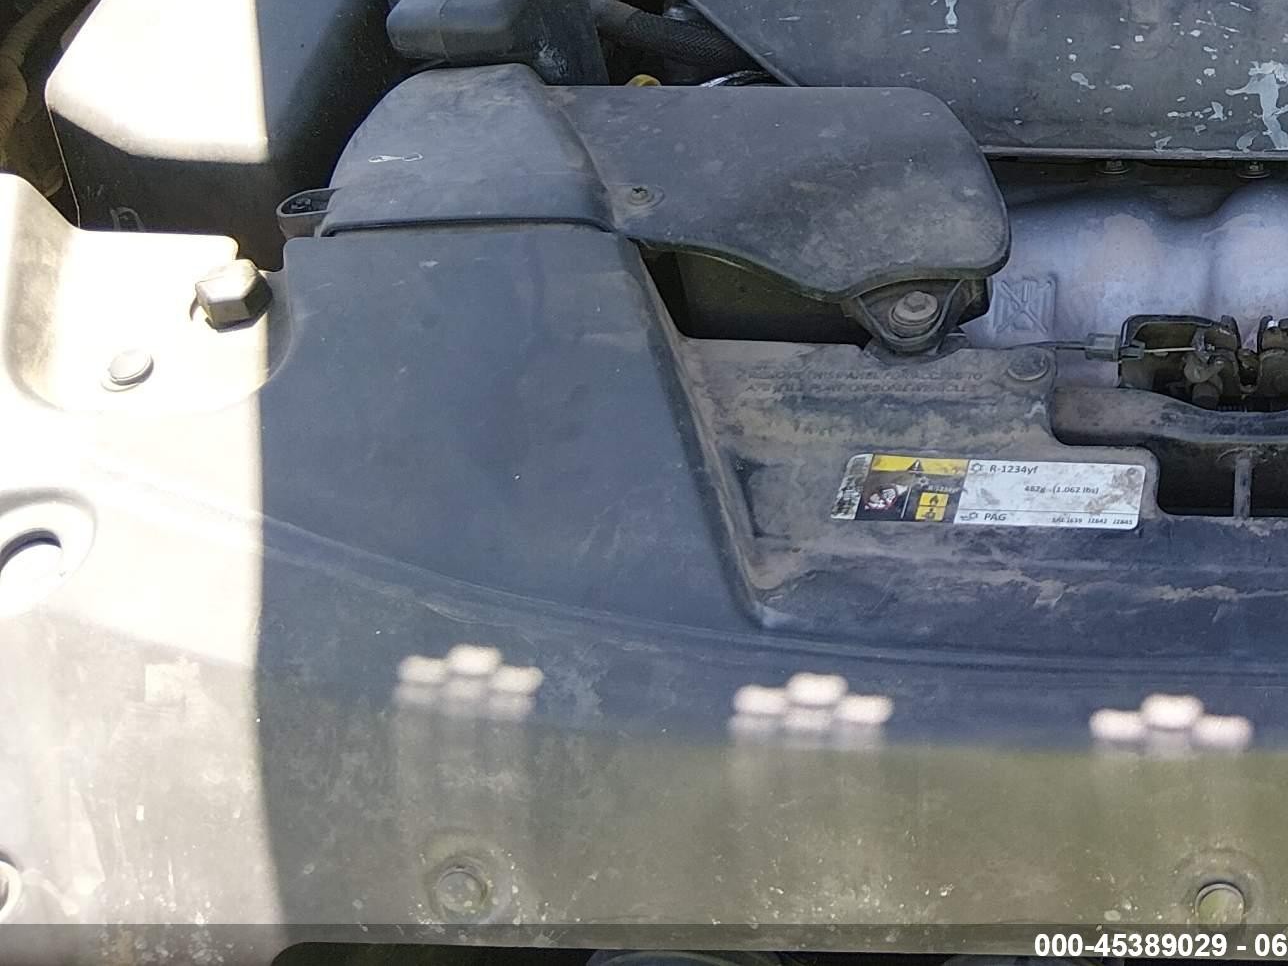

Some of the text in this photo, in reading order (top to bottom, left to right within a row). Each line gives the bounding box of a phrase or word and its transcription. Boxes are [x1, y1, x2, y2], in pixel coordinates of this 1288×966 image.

[988, 463, 1040, 476] R-1234yf
[1082, 484, 1101, 496] lbs)
[983, 512, 1009, 522] PAG
